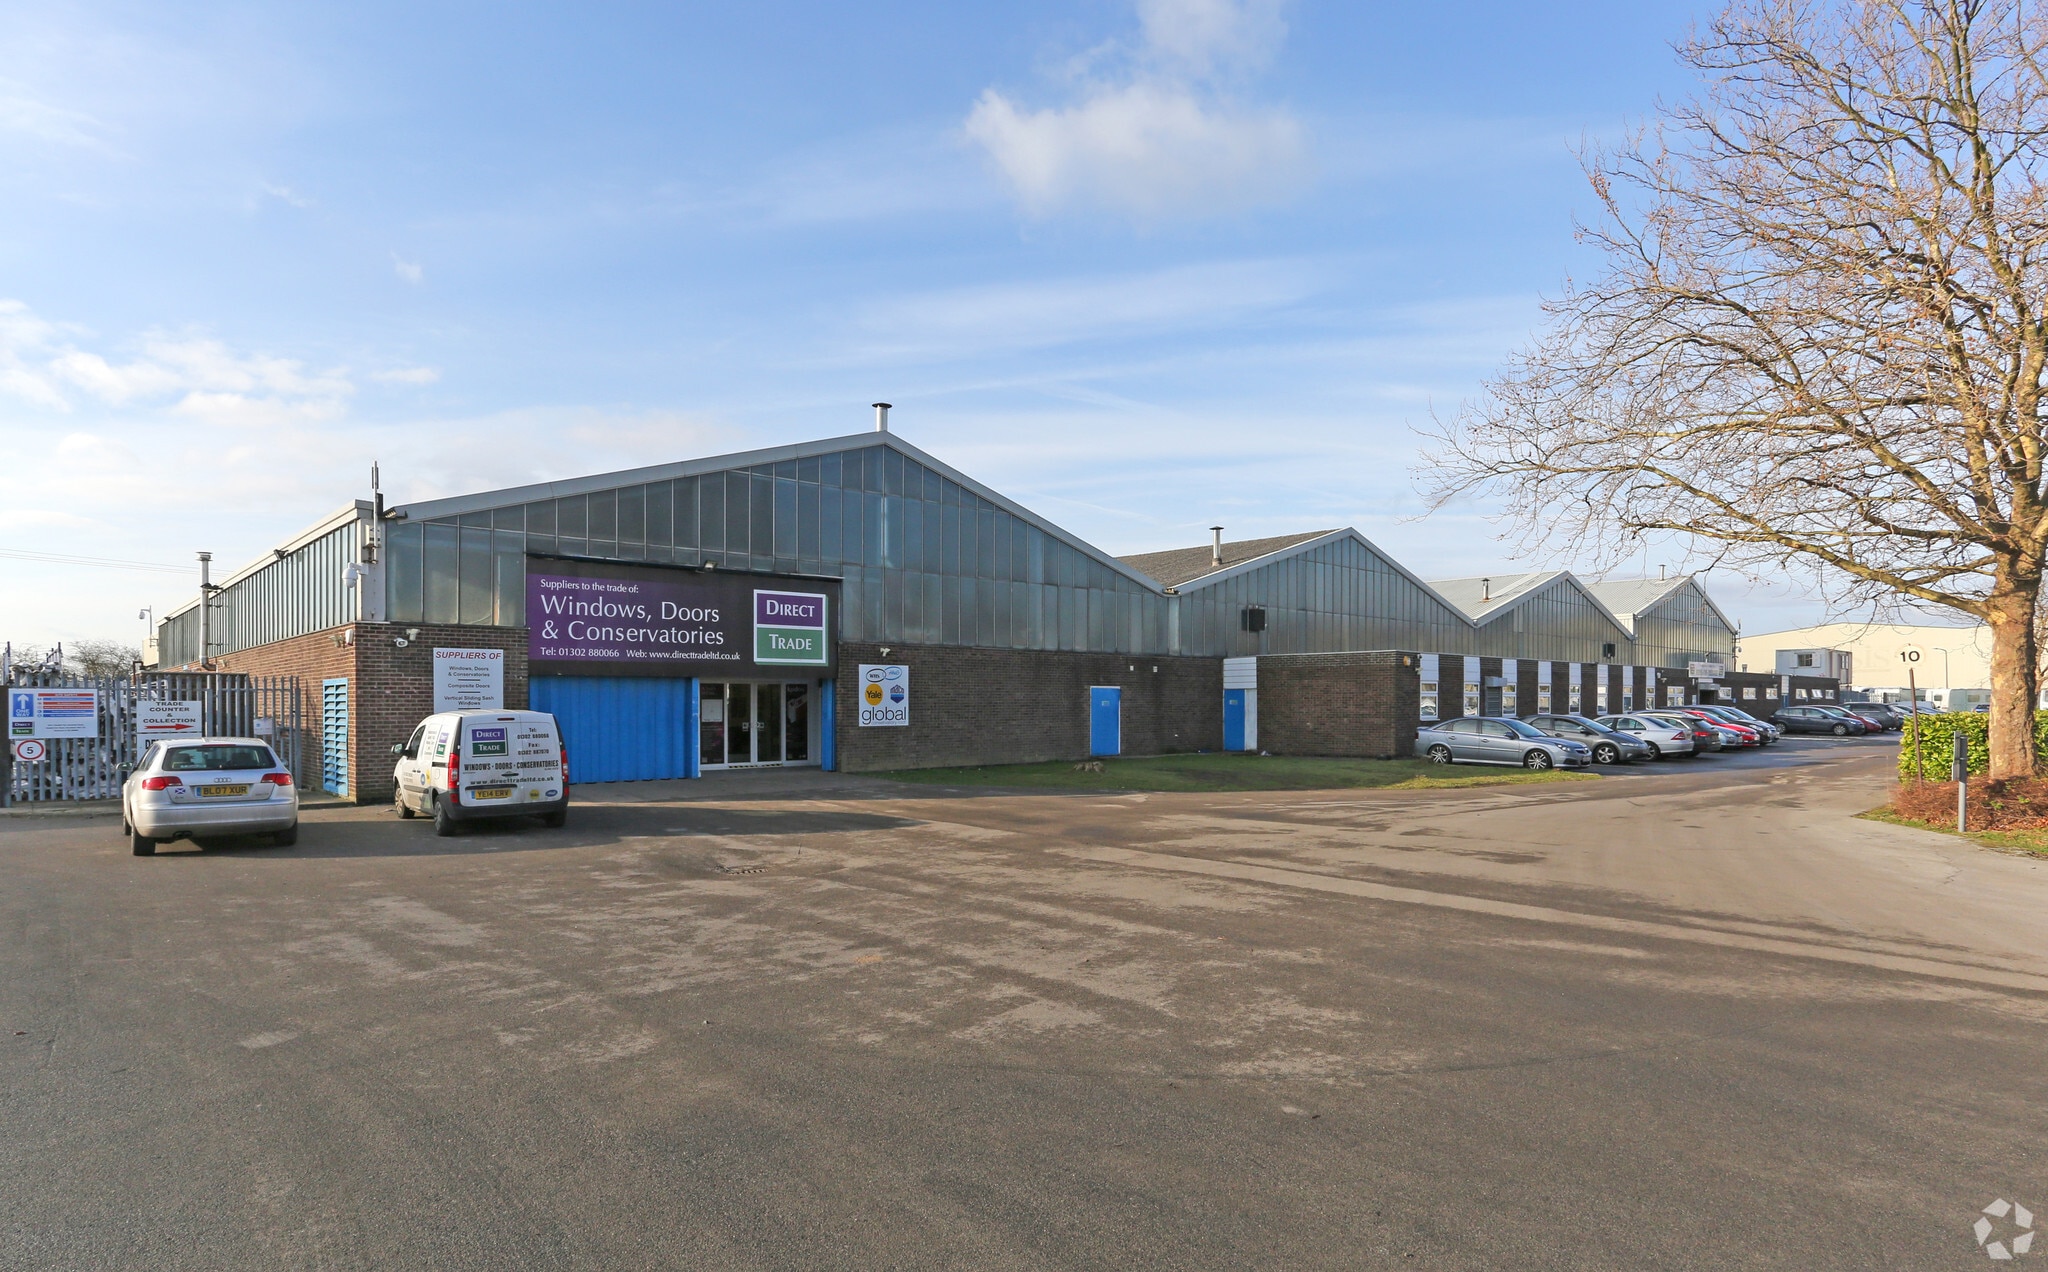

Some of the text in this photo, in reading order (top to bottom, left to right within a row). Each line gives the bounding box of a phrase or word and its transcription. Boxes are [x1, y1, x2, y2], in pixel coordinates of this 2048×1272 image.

[540, 579, 639, 593] Suppliers to the trade of:
[540, 594, 720, 623] Windows, Doors
[766, 600, 815, 618] DIRECT
[542, 620, 724, 645] & Conservatories
[769, 634, 812, 650] TRADE
[436, 651, 486, 659] SUPPLIERS
[540, 647, 740, 661] Tel: 01302 880066 Web: www.directtradeltd.co.uk
[1900, 650, 1920, 662] 10
[866, 691, 882, 699] Yale
[862, 707, 906, 725] global
[464, 763, 491, 771] WINDOWS
[517, 760, 559, 769] CONSERVATORIES
[470, 776, 554, 784] www.directtradeltd.co.uk
[203, 786, 227, 794] BL07
